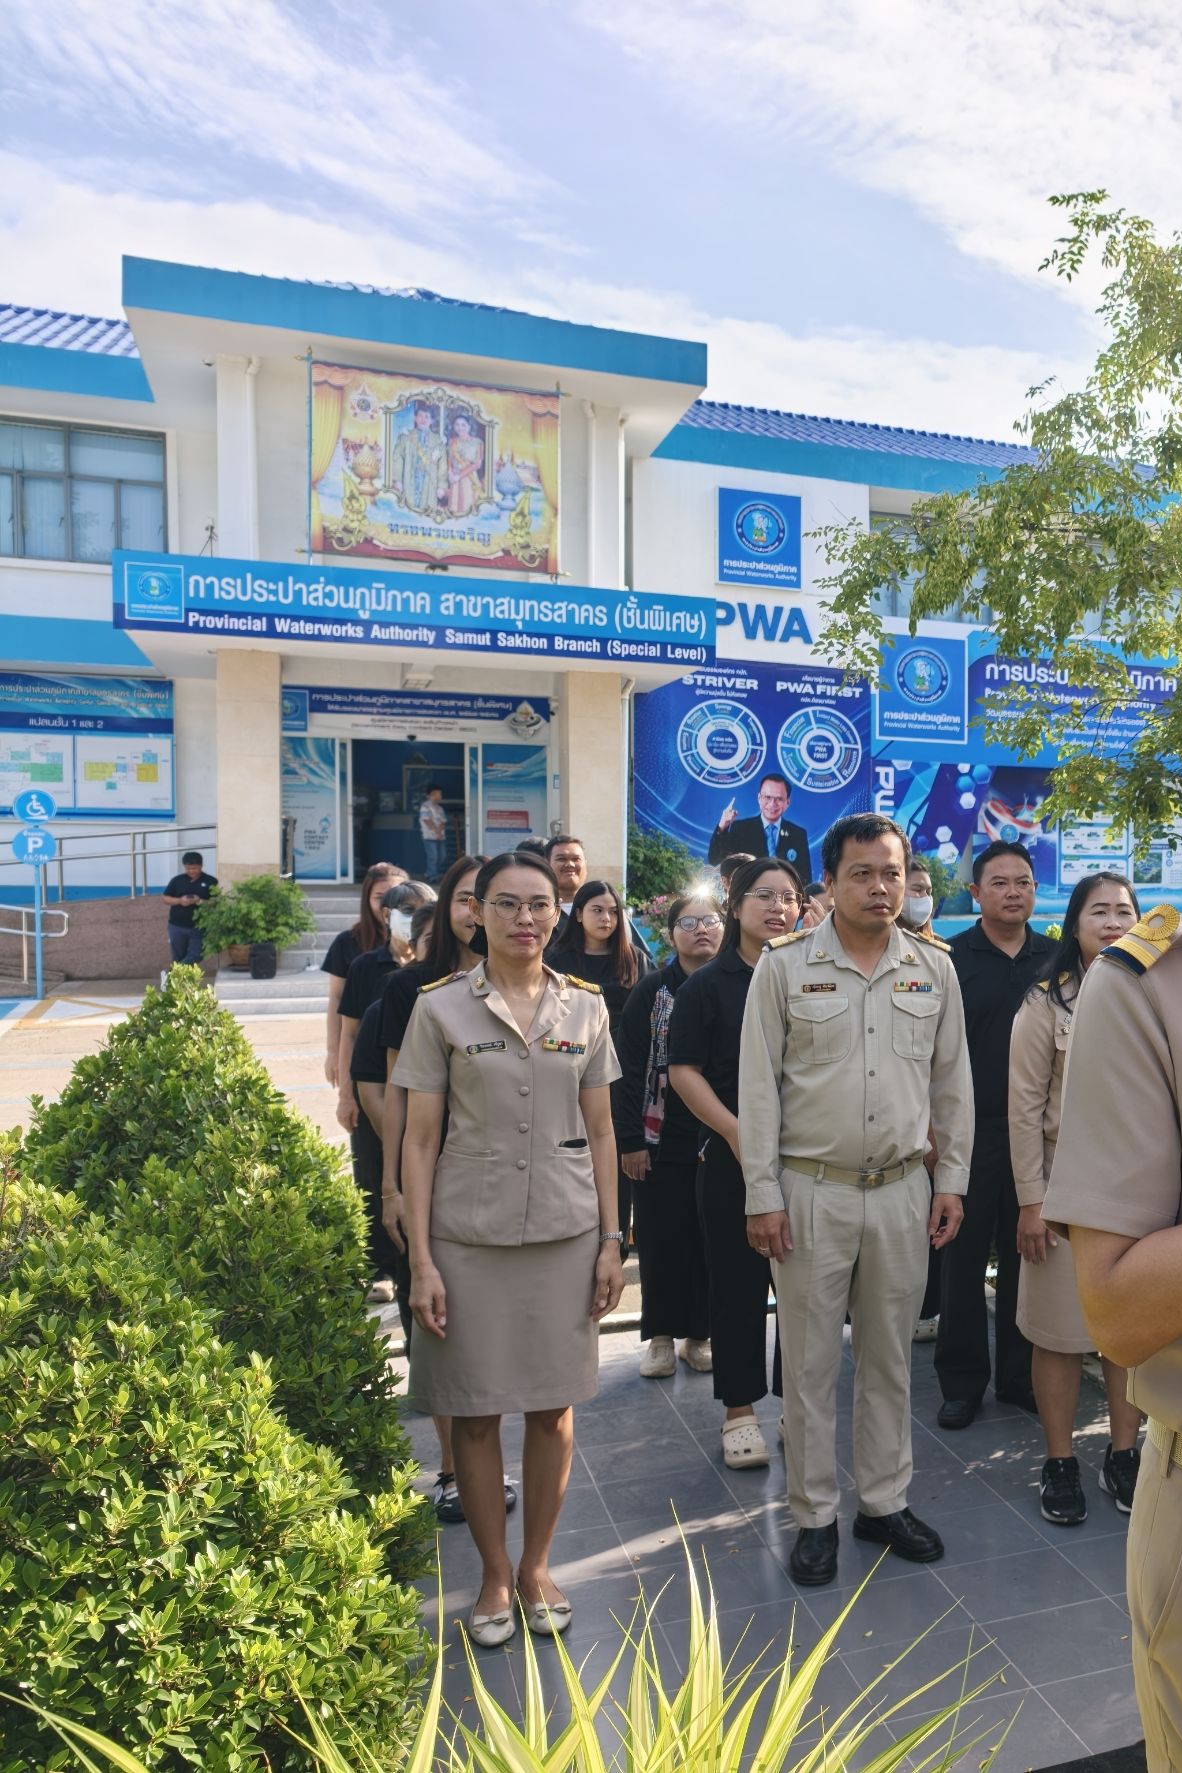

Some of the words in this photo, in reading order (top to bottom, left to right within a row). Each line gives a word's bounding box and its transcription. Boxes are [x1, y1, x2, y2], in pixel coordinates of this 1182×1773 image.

[386, 521, 492, 547] ทรงพระเจริญ
[723, 559, 798, 574] การประปาส่วนภูมิภาค
[723, 568, 746, 576] Provincial
[775, 574, 797, 582] Authority
[188, 572, 431, 620] การประปาส่วนภูมิภาค
[439, 592, 608, 630] สาขาสมุทรสาคร
[614, 595, 708, 640] (ชั้นพิเศษ)
[716, 600, 814, 645] PWA
[188, 612, 267, 633] Provincial
[274, 619, 365, 639] Waterworks
[370, 623, 436, 645] Authority
[445, 628, 491, 646] Samut
[496, 632, 548, 650] Sakhon
[554, 635, 601, 653] Branch
[606, 638, 661, 658] (Special
[666, 643, 707, 664] Level)
[682, 674, 759, 691] STRIVER
[776, 681, 812, 695] PWA
[813, 684, 864, 699] FIRST
[71, 719, 77, 728] 1
[96, 720, 104, 728] 2
[883, 711, 961, 724] การประปาส่วนภูมิภาค
[883, 721, 907, 729] Provincial
[874, 766, 895, 817] PW
[27, 837, 44, 854] P
